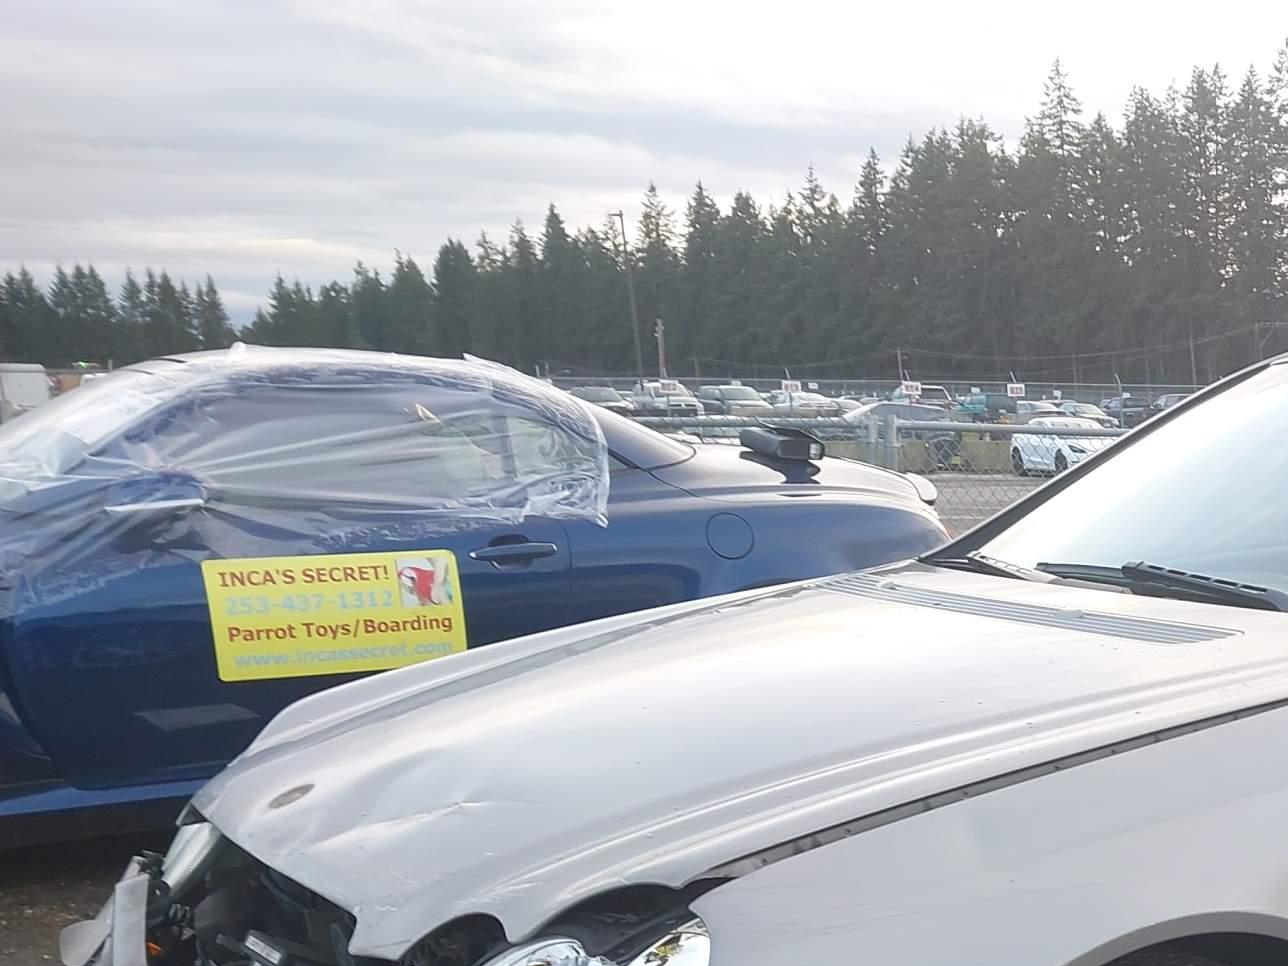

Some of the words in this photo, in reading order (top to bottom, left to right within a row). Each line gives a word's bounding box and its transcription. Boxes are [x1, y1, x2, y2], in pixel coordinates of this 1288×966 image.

[218, 569, 295, 588] INCA'S
[302, 565, 390, 583] SECRET!
[225, 590, 393, 615] 253-437-1312
[227, 626, 297, 642] Parrot
[301, 615, 453, 640] Toys/Boarding
[234, 641, 453, 667] www.incassecret.com
